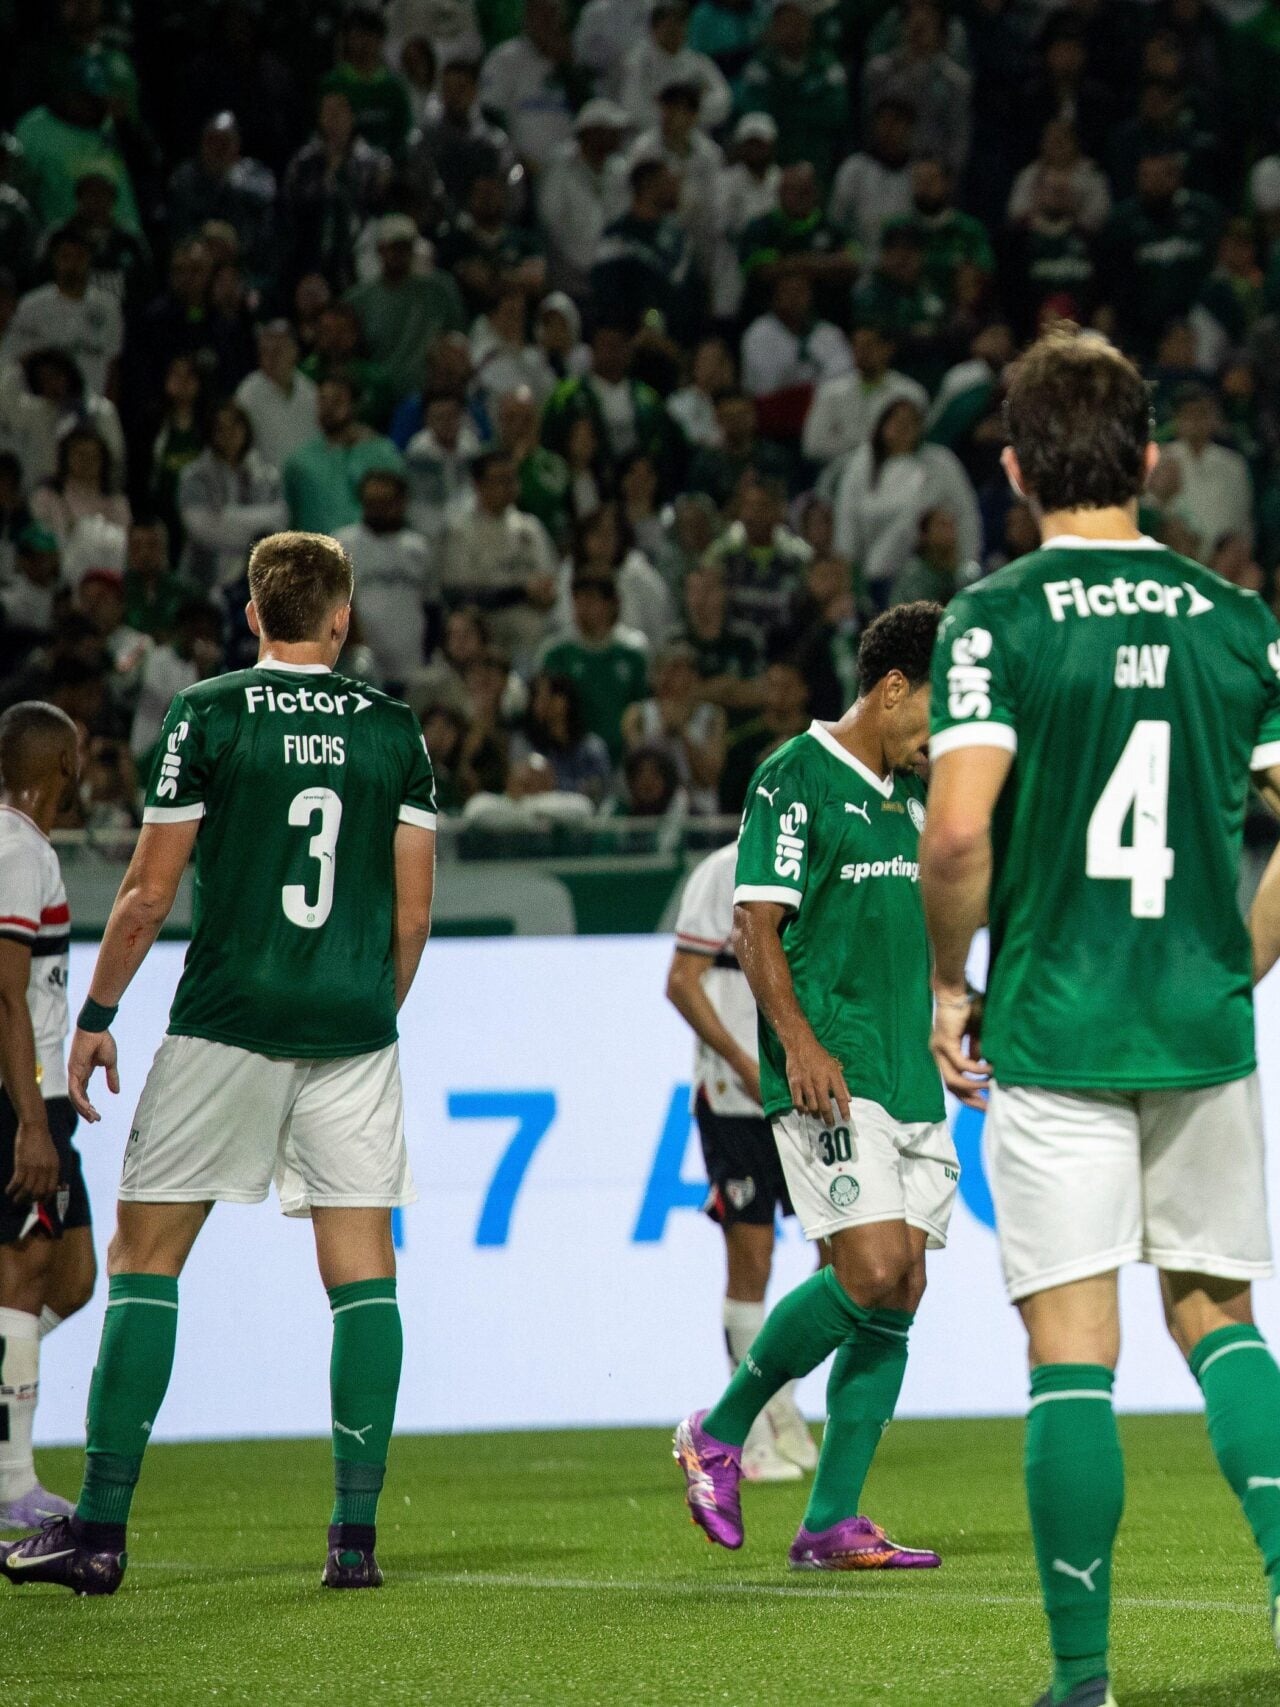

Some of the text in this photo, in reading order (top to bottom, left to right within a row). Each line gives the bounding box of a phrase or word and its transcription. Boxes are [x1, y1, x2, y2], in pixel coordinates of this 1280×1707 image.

[1043, 577, 1184, 622] Fictor
[1114, 644, 1171, 689] GIAY
[244, 685, 349, 716] Fictor
[283, 734, 346, 765] FUCHS
[1085, 718, 1175, 919] 4
[281, 786, 343, 929] 3
[393, 1087, 558, 1250] 7
[818, 1125, 852, 1167] 30
